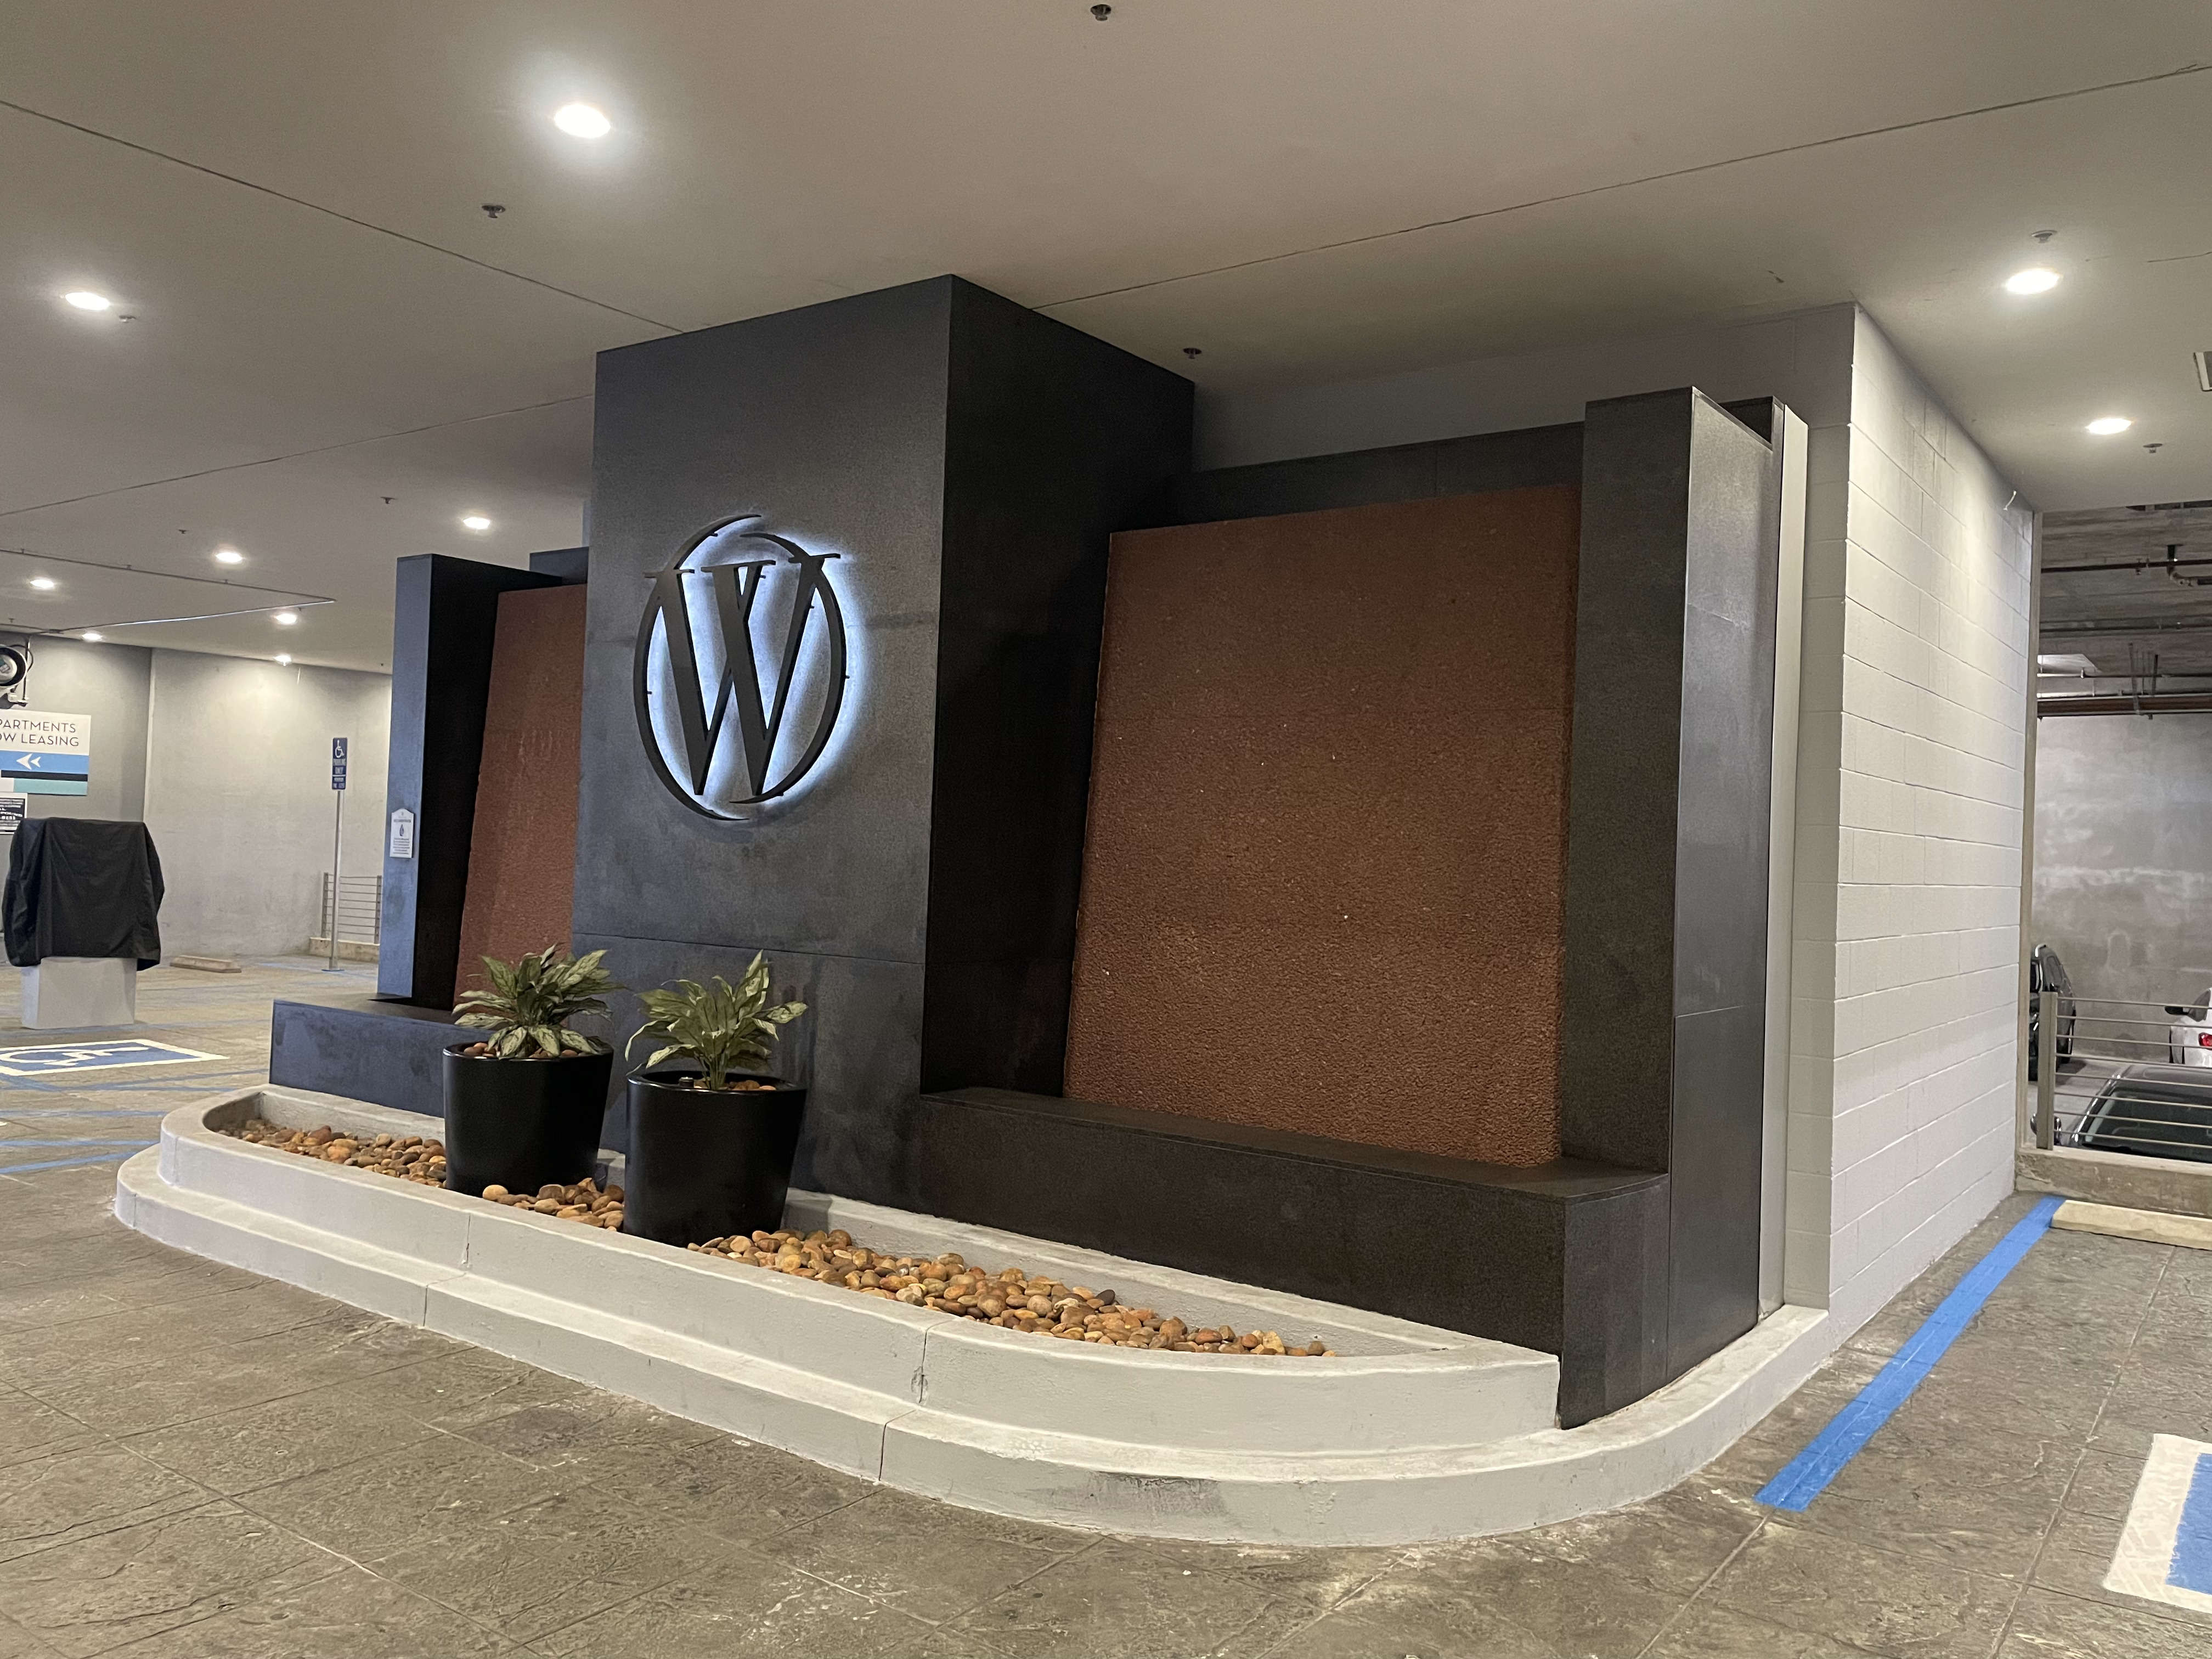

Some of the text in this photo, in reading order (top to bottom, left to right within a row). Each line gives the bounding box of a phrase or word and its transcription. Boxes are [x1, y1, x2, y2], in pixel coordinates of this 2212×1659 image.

[0, 732, 79, 747] W LEASING
[644, 552, 841, 797] W
